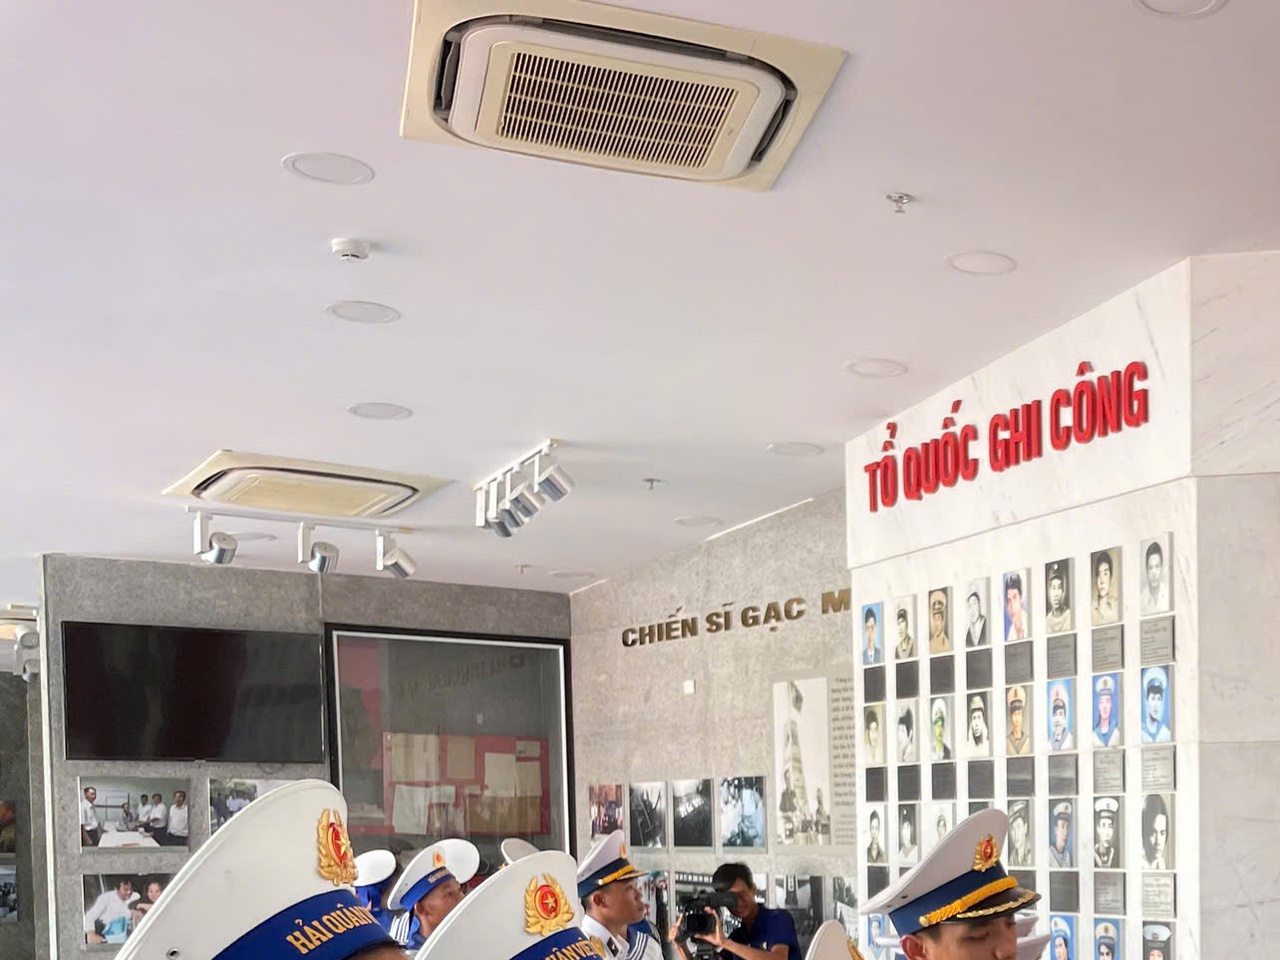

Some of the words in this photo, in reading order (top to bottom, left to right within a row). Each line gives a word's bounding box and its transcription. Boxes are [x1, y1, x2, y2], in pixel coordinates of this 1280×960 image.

[864, 422, 899, 513] TỔ
[903, 399, 979, 502] QUỐC
[989, 400, 1043, 473] GHI
[1049, 361, 1149, 453] CÔNG
[622, 608, 699, 649] CHIẾN
[706, 601, 733, 636] SĨ
[741, 597, 808, 633] GẠC
[821, 587, 853, 616] M
[286, 919, 334, 955] HẢI
[322, 903, 373, 934] QUÂN
